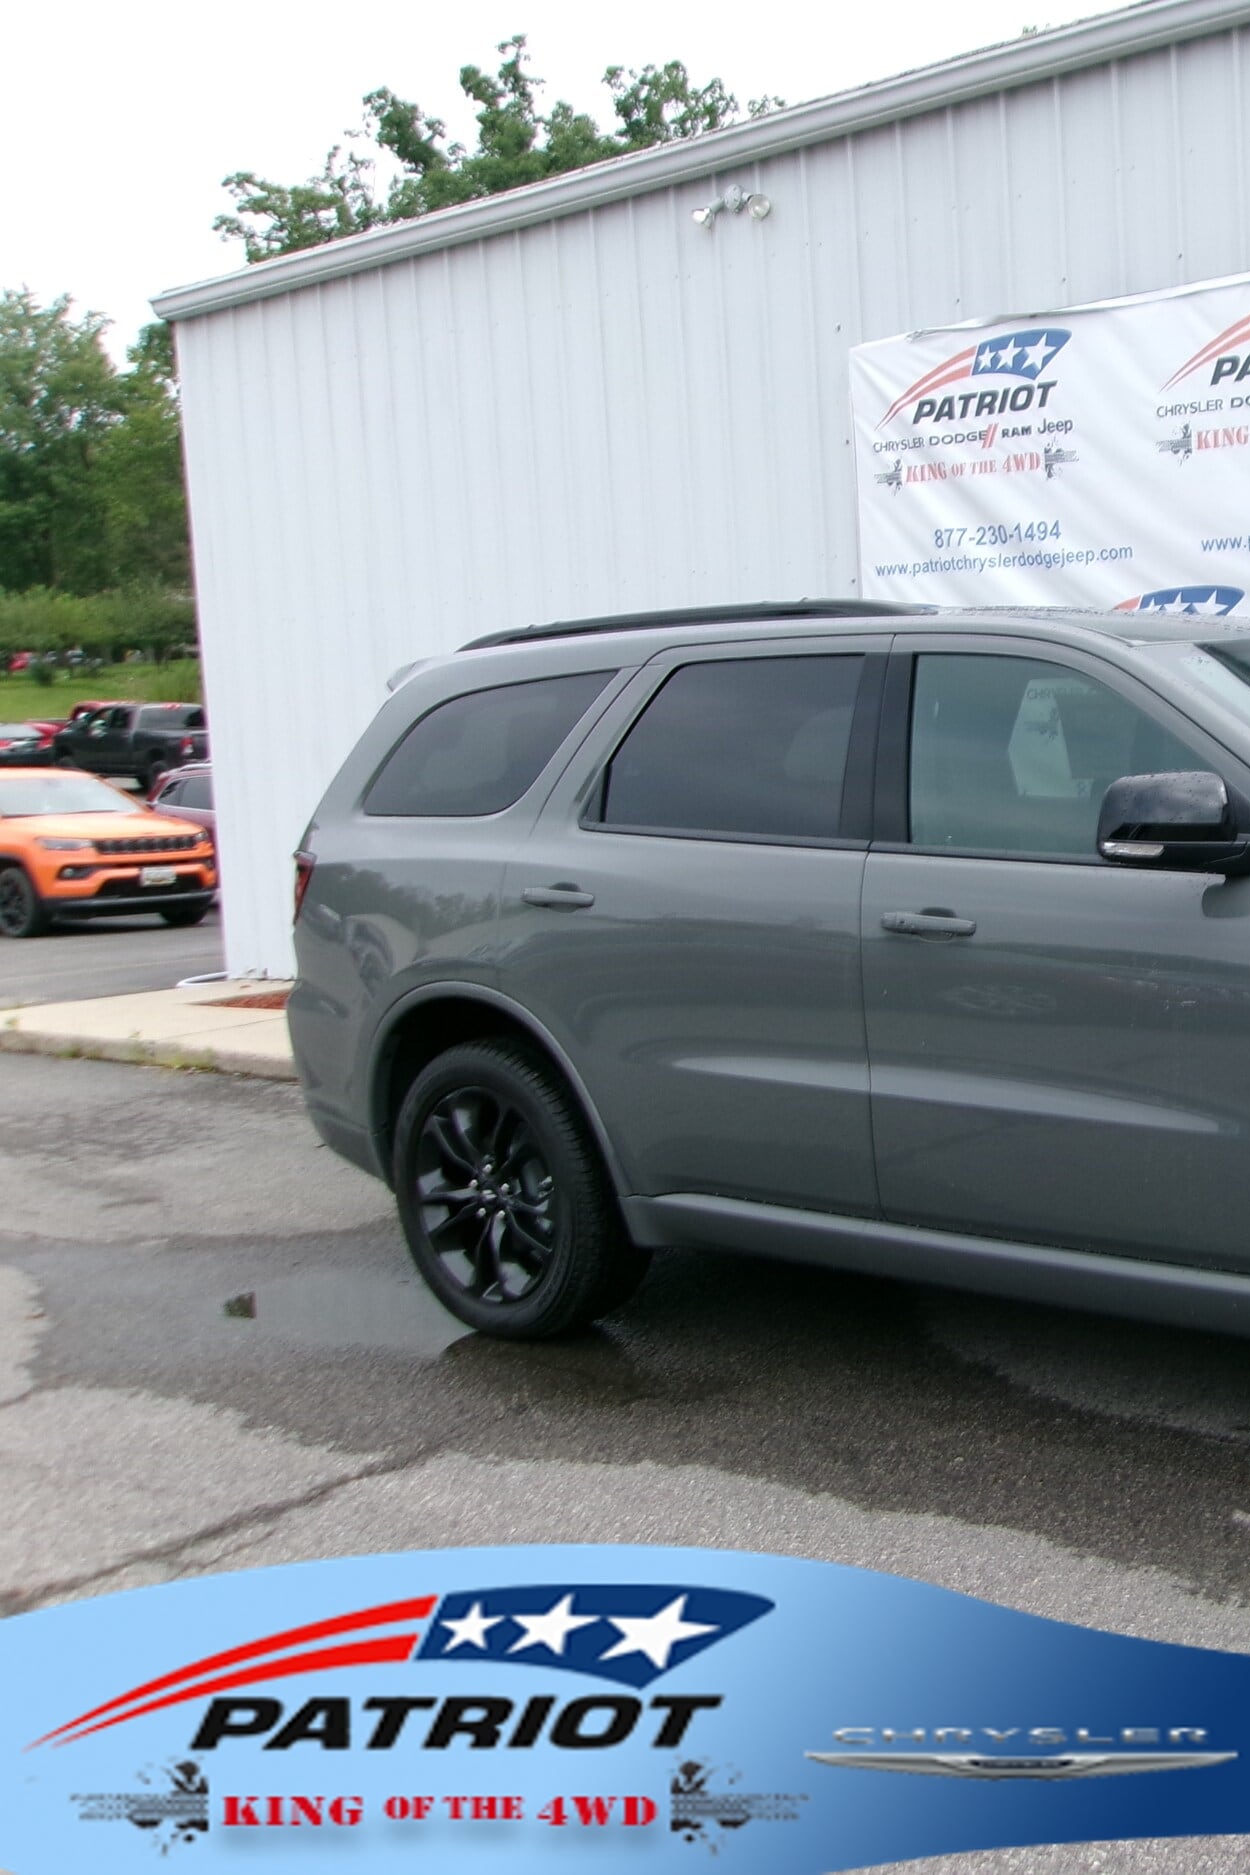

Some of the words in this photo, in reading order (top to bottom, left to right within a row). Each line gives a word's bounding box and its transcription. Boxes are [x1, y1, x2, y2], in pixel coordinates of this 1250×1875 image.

[912, 380, 1057, 424] PATRIOT
[1156, 400, 1224, 418] CHRYSLER
[873, 437, 925, 453] CHRYSLER
[929, 430, 988, 446] DODGE
[1001, 425, 1032, 439] RAM
[1037, 417, 1073, 436] Jeep
[1196, 426, 1250, 451] KING
[905, 461, 948, 483] KING
[951, 461, 967, 476] OF
[970, 458, 997, 474] THE
[1002, 452, 1041, 473] 4WD
[934, 520, 1062, 549] 877-230-1494
[875, 545, 1133, 577] www.patriotchryslerdodgejeep.com
